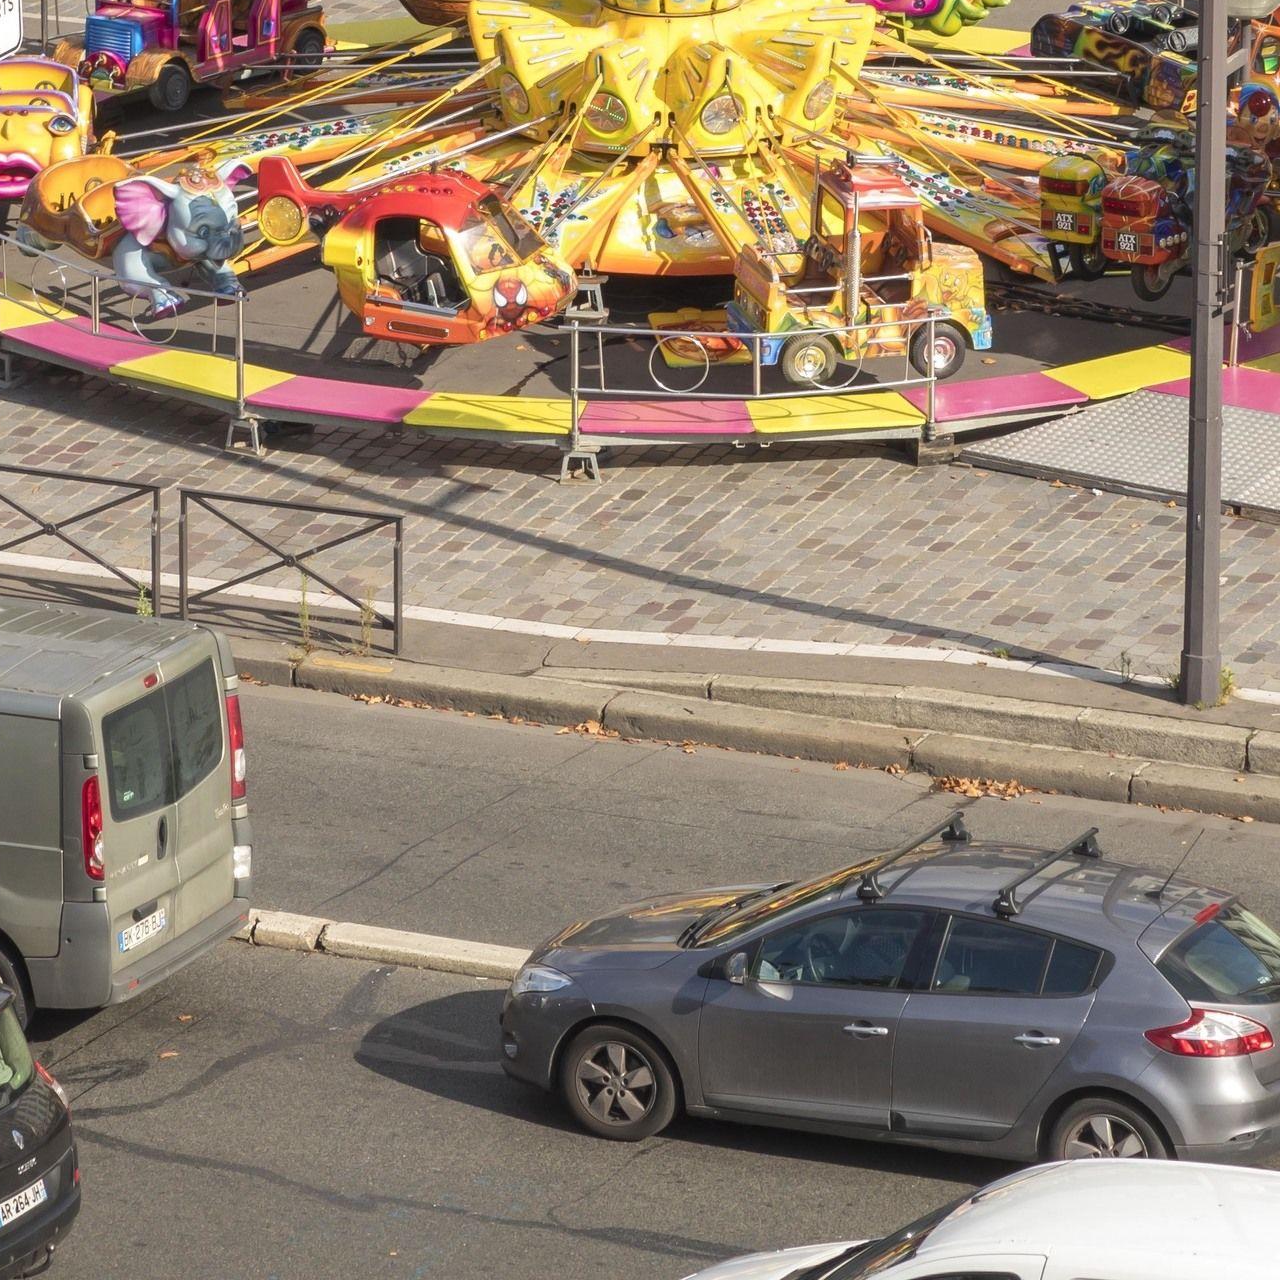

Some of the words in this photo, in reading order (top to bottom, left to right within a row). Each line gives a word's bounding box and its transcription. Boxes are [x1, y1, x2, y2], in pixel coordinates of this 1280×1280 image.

[1056, 213, 1074, 224] ATX
[1057, 222, 1072, 231] 921
[1118, 233, 1136, 244] ATX
[1119, 242, 1135, 251] 921
